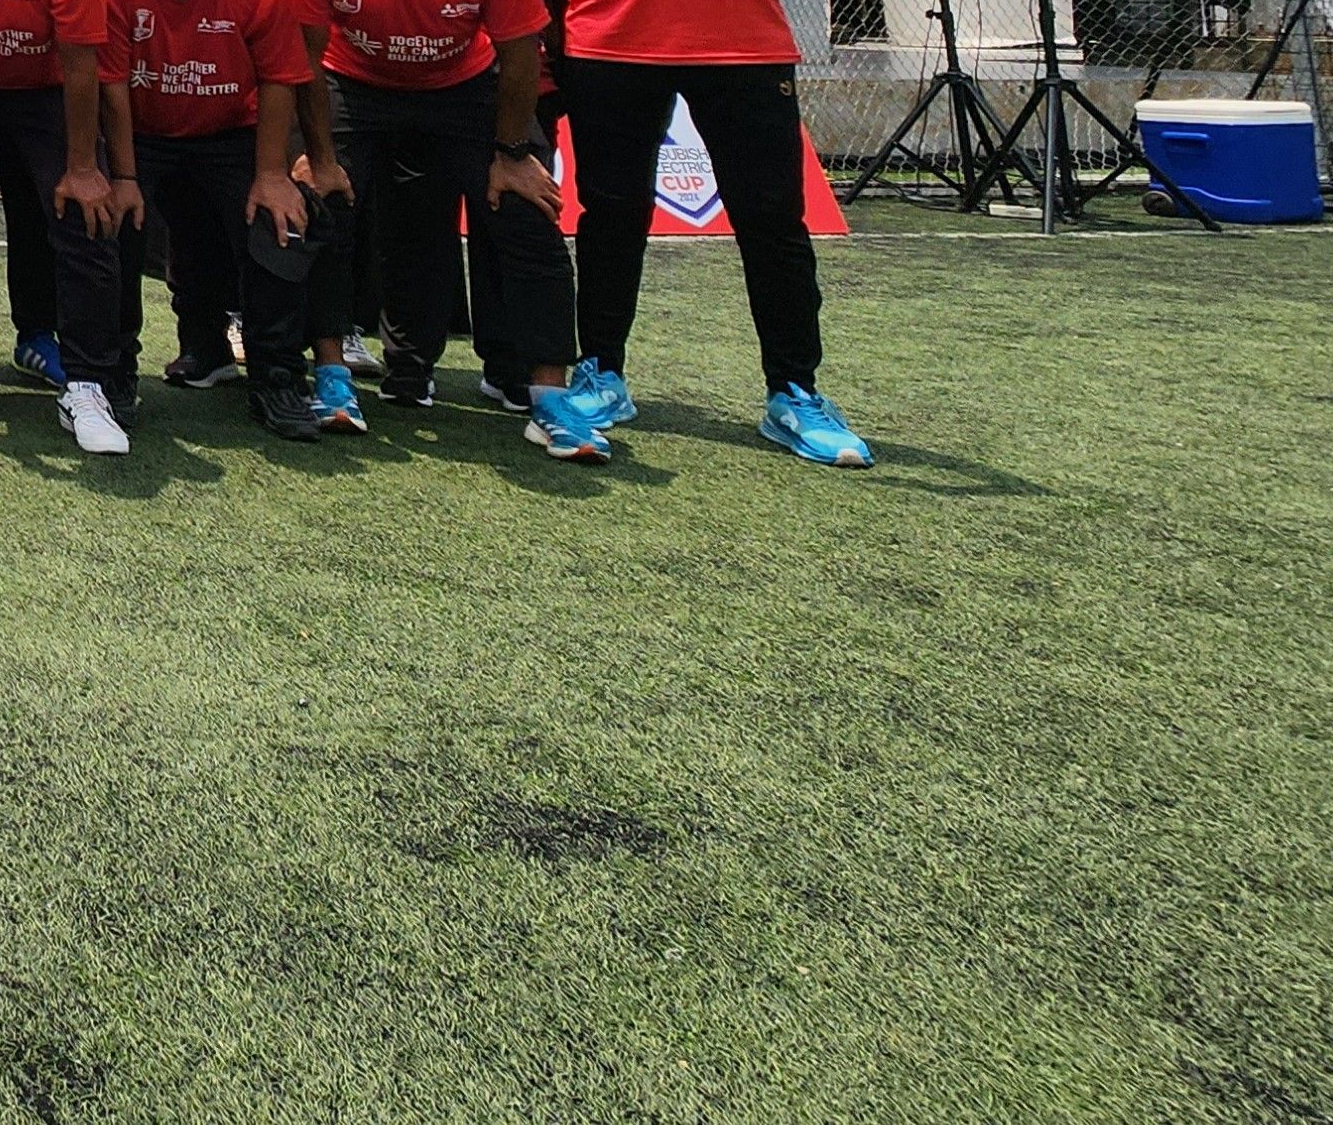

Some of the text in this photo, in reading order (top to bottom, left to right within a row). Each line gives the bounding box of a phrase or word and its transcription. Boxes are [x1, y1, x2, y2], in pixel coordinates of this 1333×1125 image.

[389, 35, 454, 47] TOGETHER
[388, 45, 438, 56] WE CAN
[163, 61, 217, 75] TOGETHER
[161, 72, 201, 85] WE CAN
[161, 83, 239, 95] BUILD BETTER
[658, 147, 710, 161] SUBISH
[657, 161, 712, 174] ECTRIC
[662, 176, 705, 191] CUP
